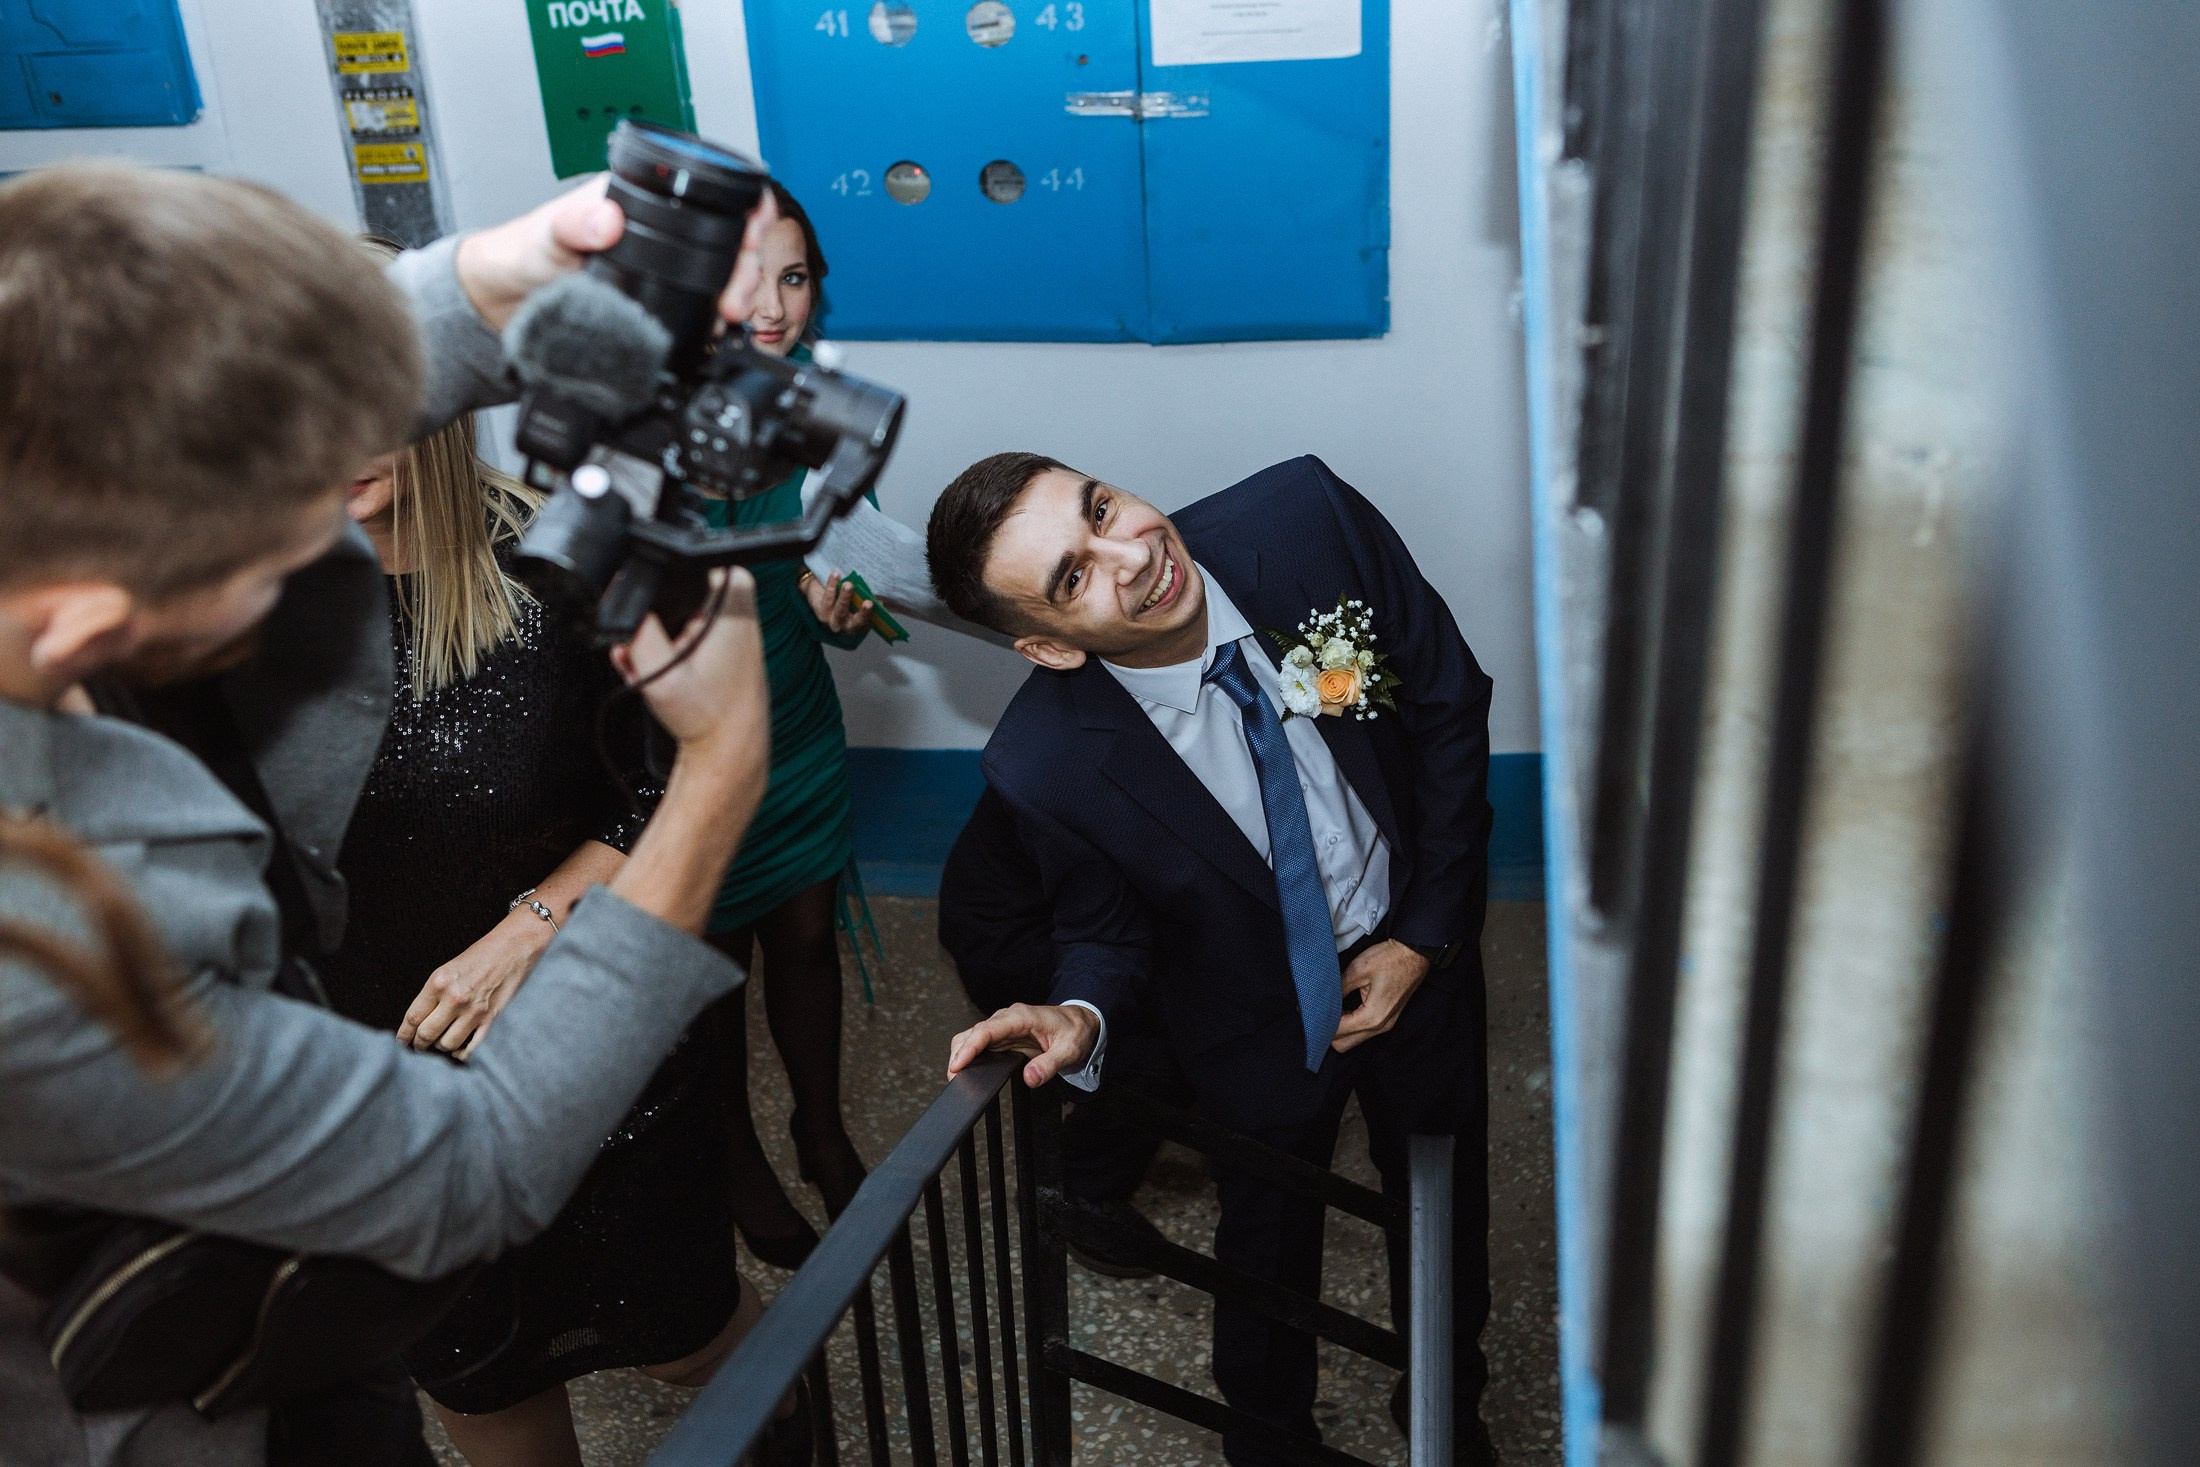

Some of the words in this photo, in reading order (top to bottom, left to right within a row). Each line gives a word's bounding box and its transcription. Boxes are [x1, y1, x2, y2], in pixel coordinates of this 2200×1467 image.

[547, 0, 646, 28] ПОЧТА
[815, 9, 849, 38] 41
[1035, 1, 1085, 31] 43
[831, 169, 872, 196] 42
[1041, 167, 1084, 191] 44
